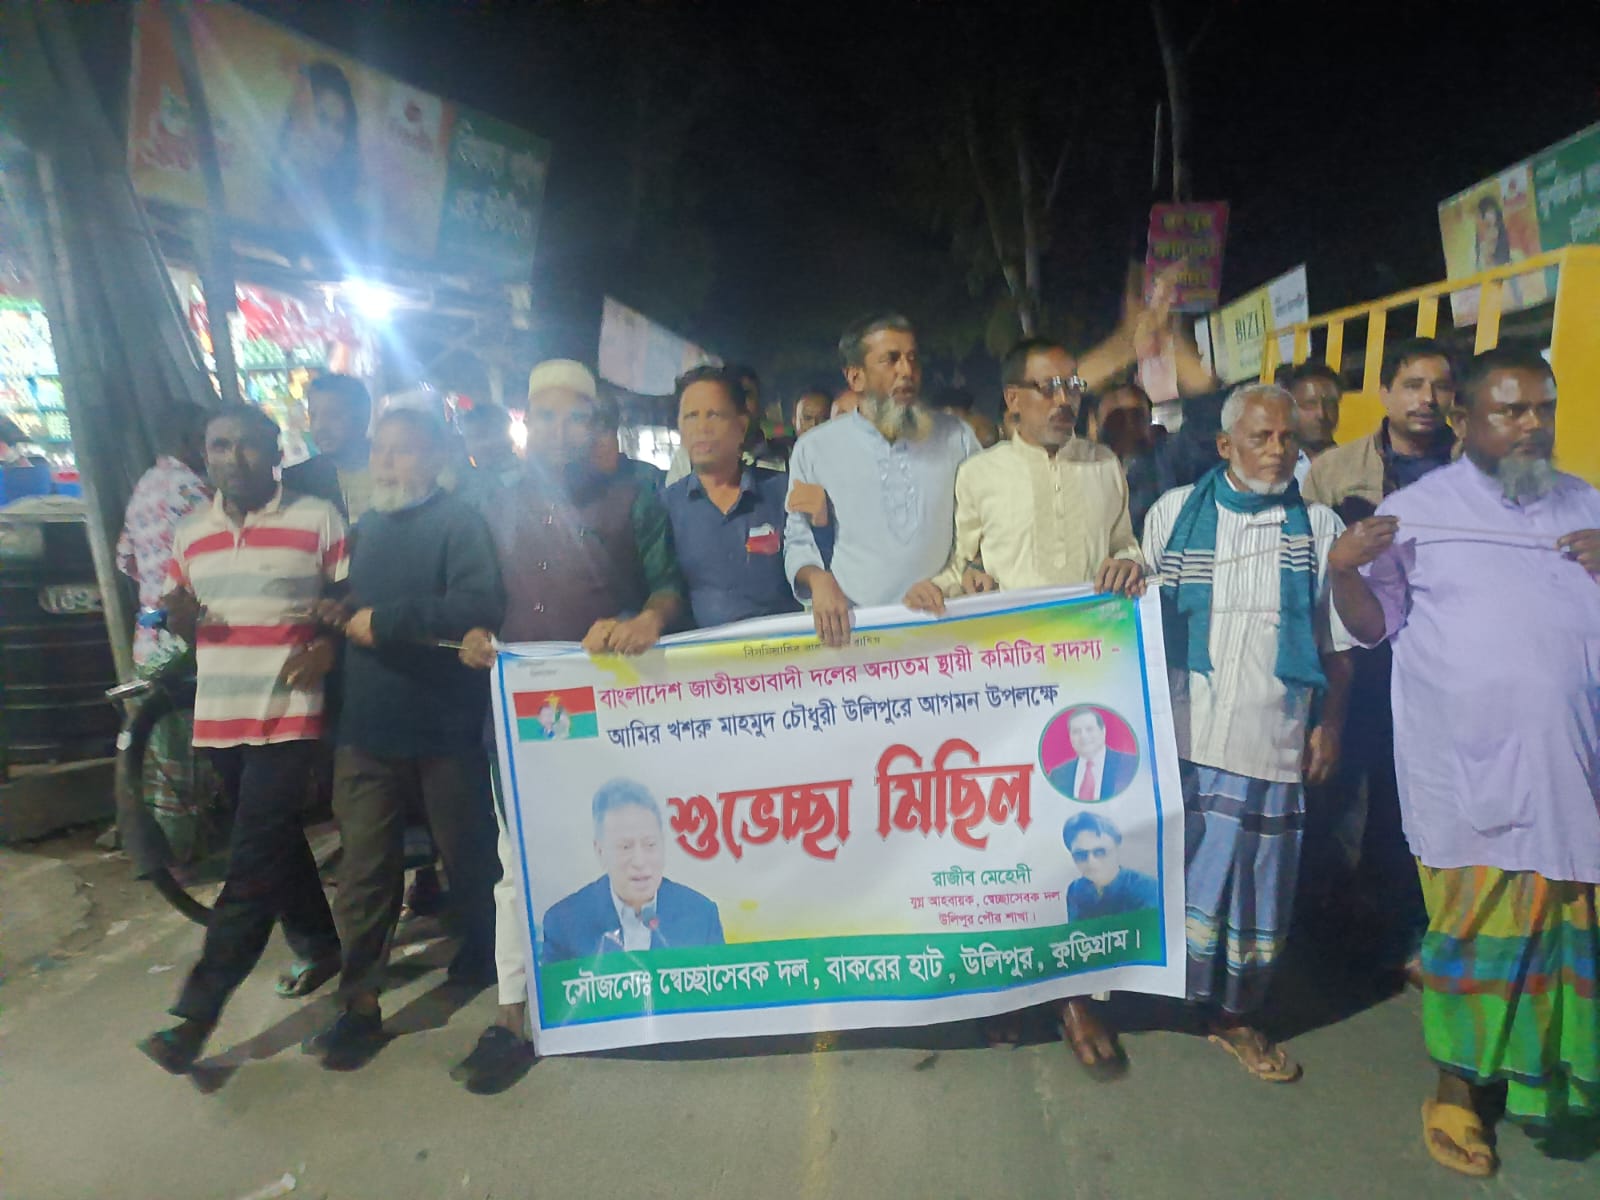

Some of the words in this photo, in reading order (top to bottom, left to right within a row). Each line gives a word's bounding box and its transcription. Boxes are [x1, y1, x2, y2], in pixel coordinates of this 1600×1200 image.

[599, 681, 683, 710] বাংলাদেশ
[688, 664, 803, 699] জাতীয়তাবাদী
[809, 664, 858, 688] দলের
[863, 655, 930, 680] অন্যতম
[935, 644, 973, 678] স্থায়ী
[979, 638, 1046, 670] কমিটির
[1053, 638, 1103, 662] সদস্য
[607, 719, 661, 748] আমির
[667, 717, 713, 742] খশরু
[718, 711, 777, 738] মাহমুদ
[782, 697, 837, 732] চৌধুরী
[842, 694, 912, 725] উলিপুরে
[917, 690, 980, 716] আগমন
[984, 682, 1060, 710] উপলক্ষে
[667, 778, 853, 862] শুভেচ্ছা
[874, 737, 1035, 850] মিছিল
[931, 864, 975, 887] রাজীব
[981, 862, 1033, 885] মেহেদী
[1043, 890, 1061, 902] দল
[939, 911, 975, 928] উলিপুর
[977, 910, 1002, 926] পৌর
[562, 968, 652, 1006] সৌজন্যেঃ
[657, 961, 770, 996] স্বেচ্ছাসেবক
[824, 954, 901, 984] বাকরের
